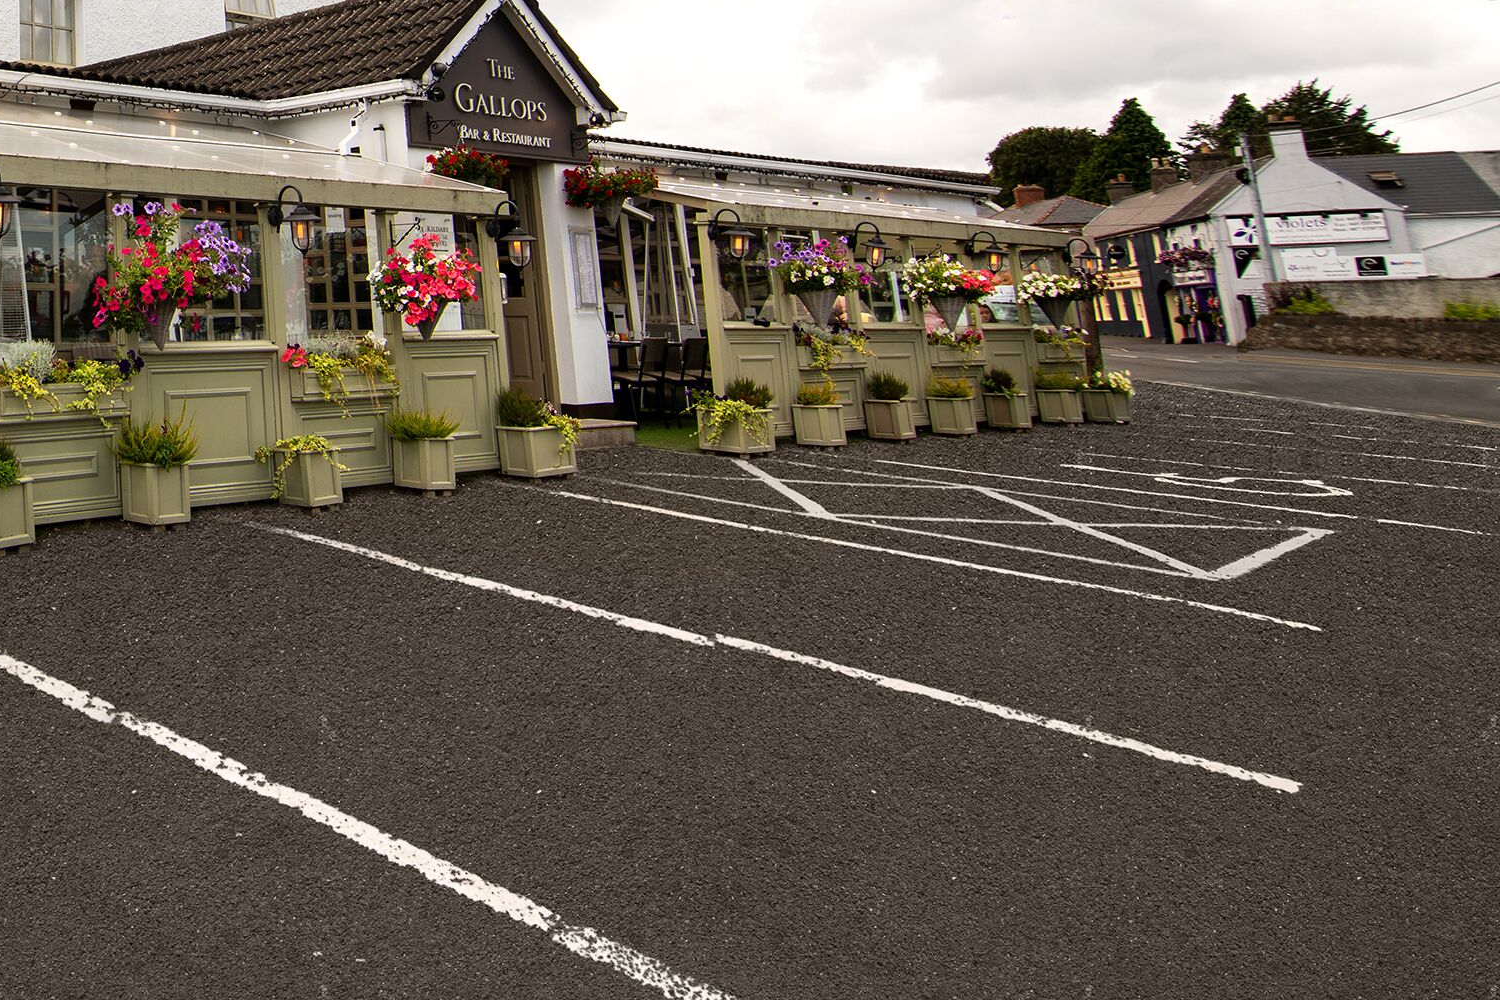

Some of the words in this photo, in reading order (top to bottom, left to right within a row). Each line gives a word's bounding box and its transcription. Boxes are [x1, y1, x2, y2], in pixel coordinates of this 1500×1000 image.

[486, 58, 515, 80] THE
[455, 82, 547, 122] GALLOPS
[459, 124, 481, 140] BAR
[483, 130, 491, 141] &
[492, 127, 552, 148] RESTAURANT
